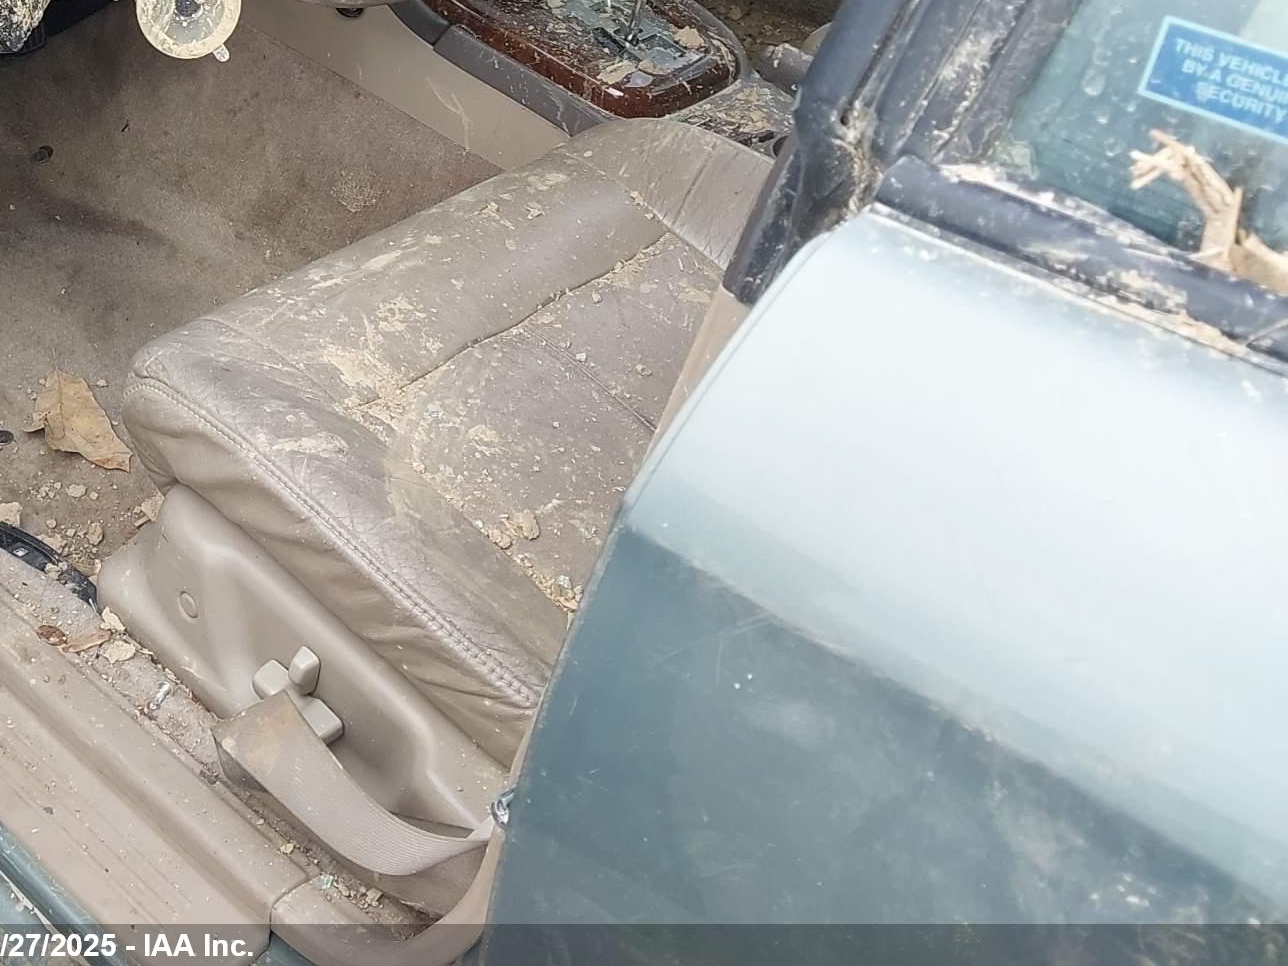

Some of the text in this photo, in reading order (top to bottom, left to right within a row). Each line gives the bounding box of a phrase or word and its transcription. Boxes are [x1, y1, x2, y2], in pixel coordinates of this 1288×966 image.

[1175, 37, 1215, 62] THIS
[1181, 59, 1208, 76] BY
[1209, 68, 1221, 83] A
